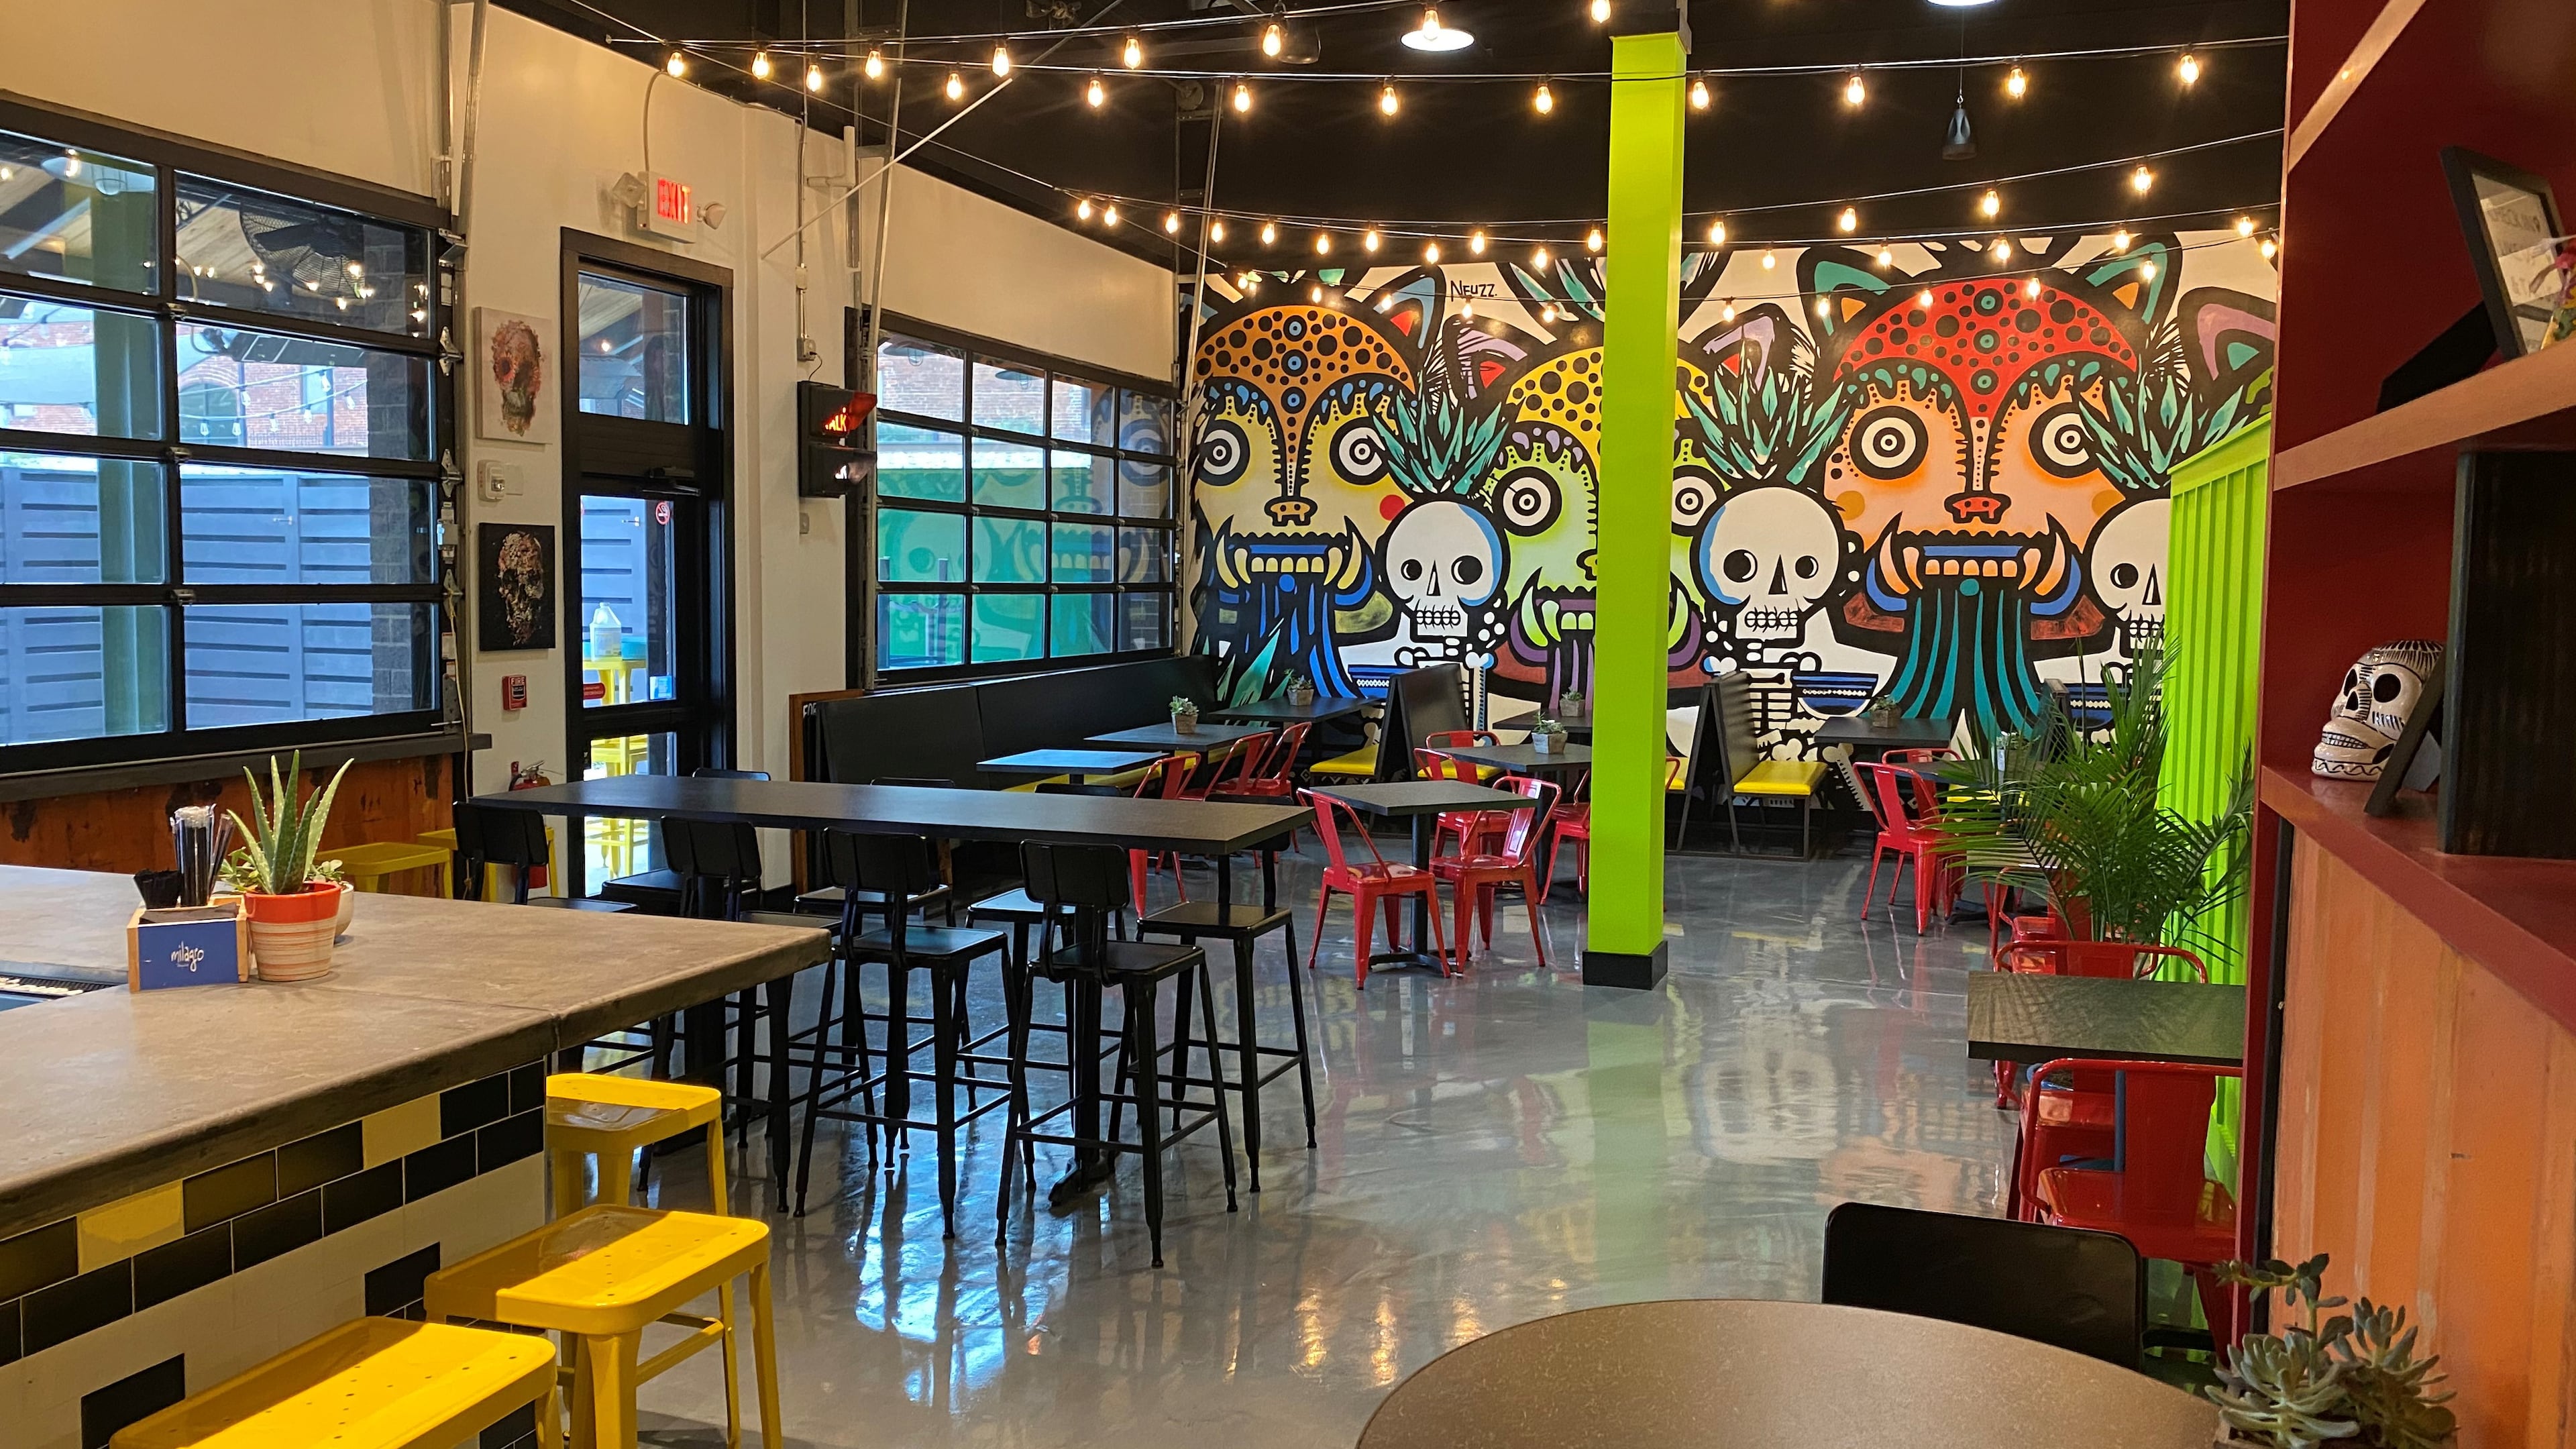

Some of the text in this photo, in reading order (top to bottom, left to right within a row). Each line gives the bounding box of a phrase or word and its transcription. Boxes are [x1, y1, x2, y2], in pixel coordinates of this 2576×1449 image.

[658, 178, 691, 225] EXIT
[511, 677, 525, 685] FIRE
[170, 941, 204, 972] milagro
